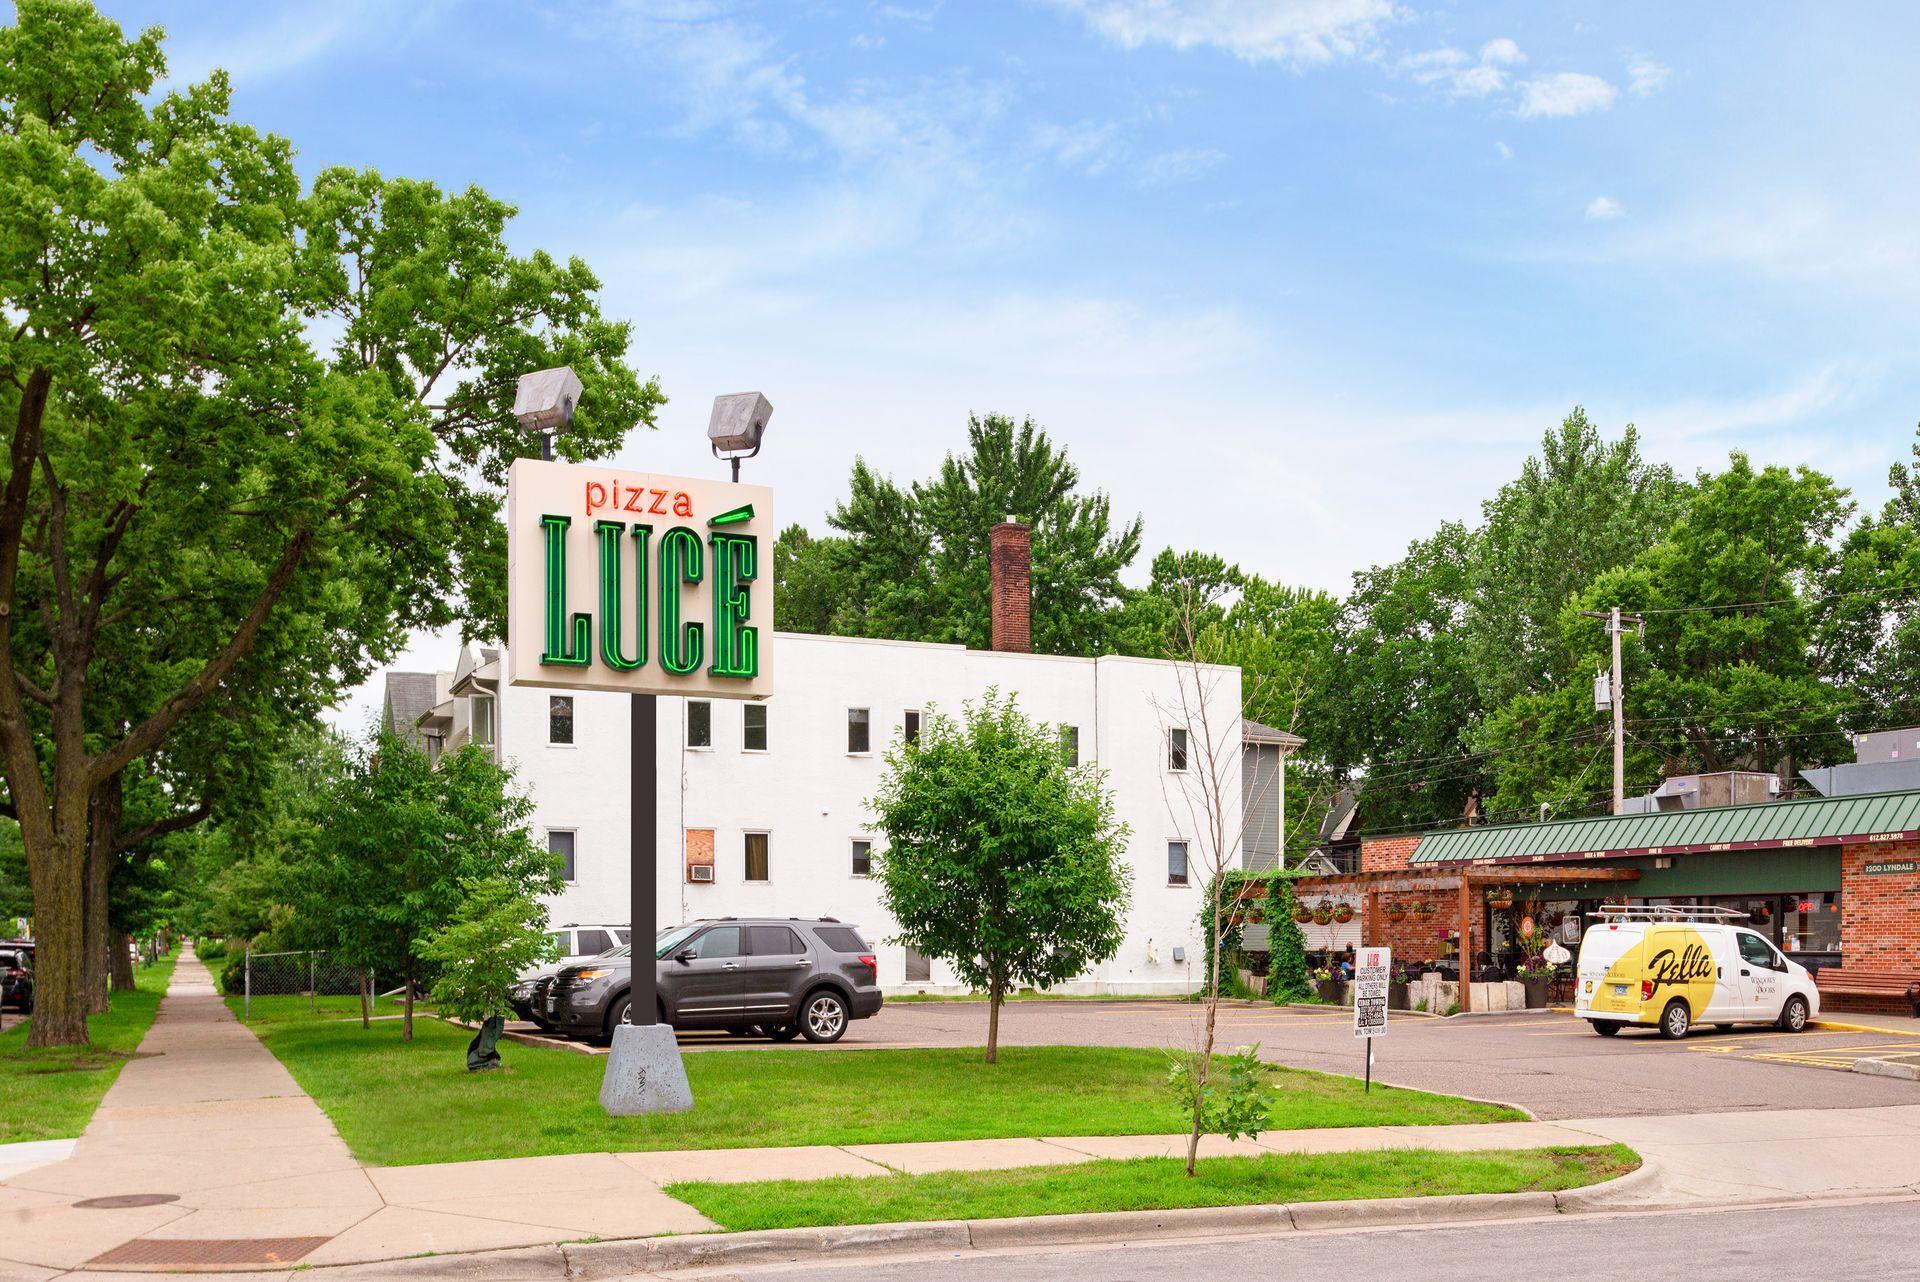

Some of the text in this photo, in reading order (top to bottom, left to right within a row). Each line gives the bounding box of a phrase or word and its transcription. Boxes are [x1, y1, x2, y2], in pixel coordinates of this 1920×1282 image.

[586, 479, 694, 518] pizza
[539, 504, 758, 679] LUCÉ
[1869, 833, 1903, 841] 612.827.5978
[1883, 863, 1914, 871] LYNDALE
[1360, 966, 1386, 974] CUSTOMER
[1648, 944, 1713, 995] Pella
[1356, 973, 1388, 982] PARKING ONLY
